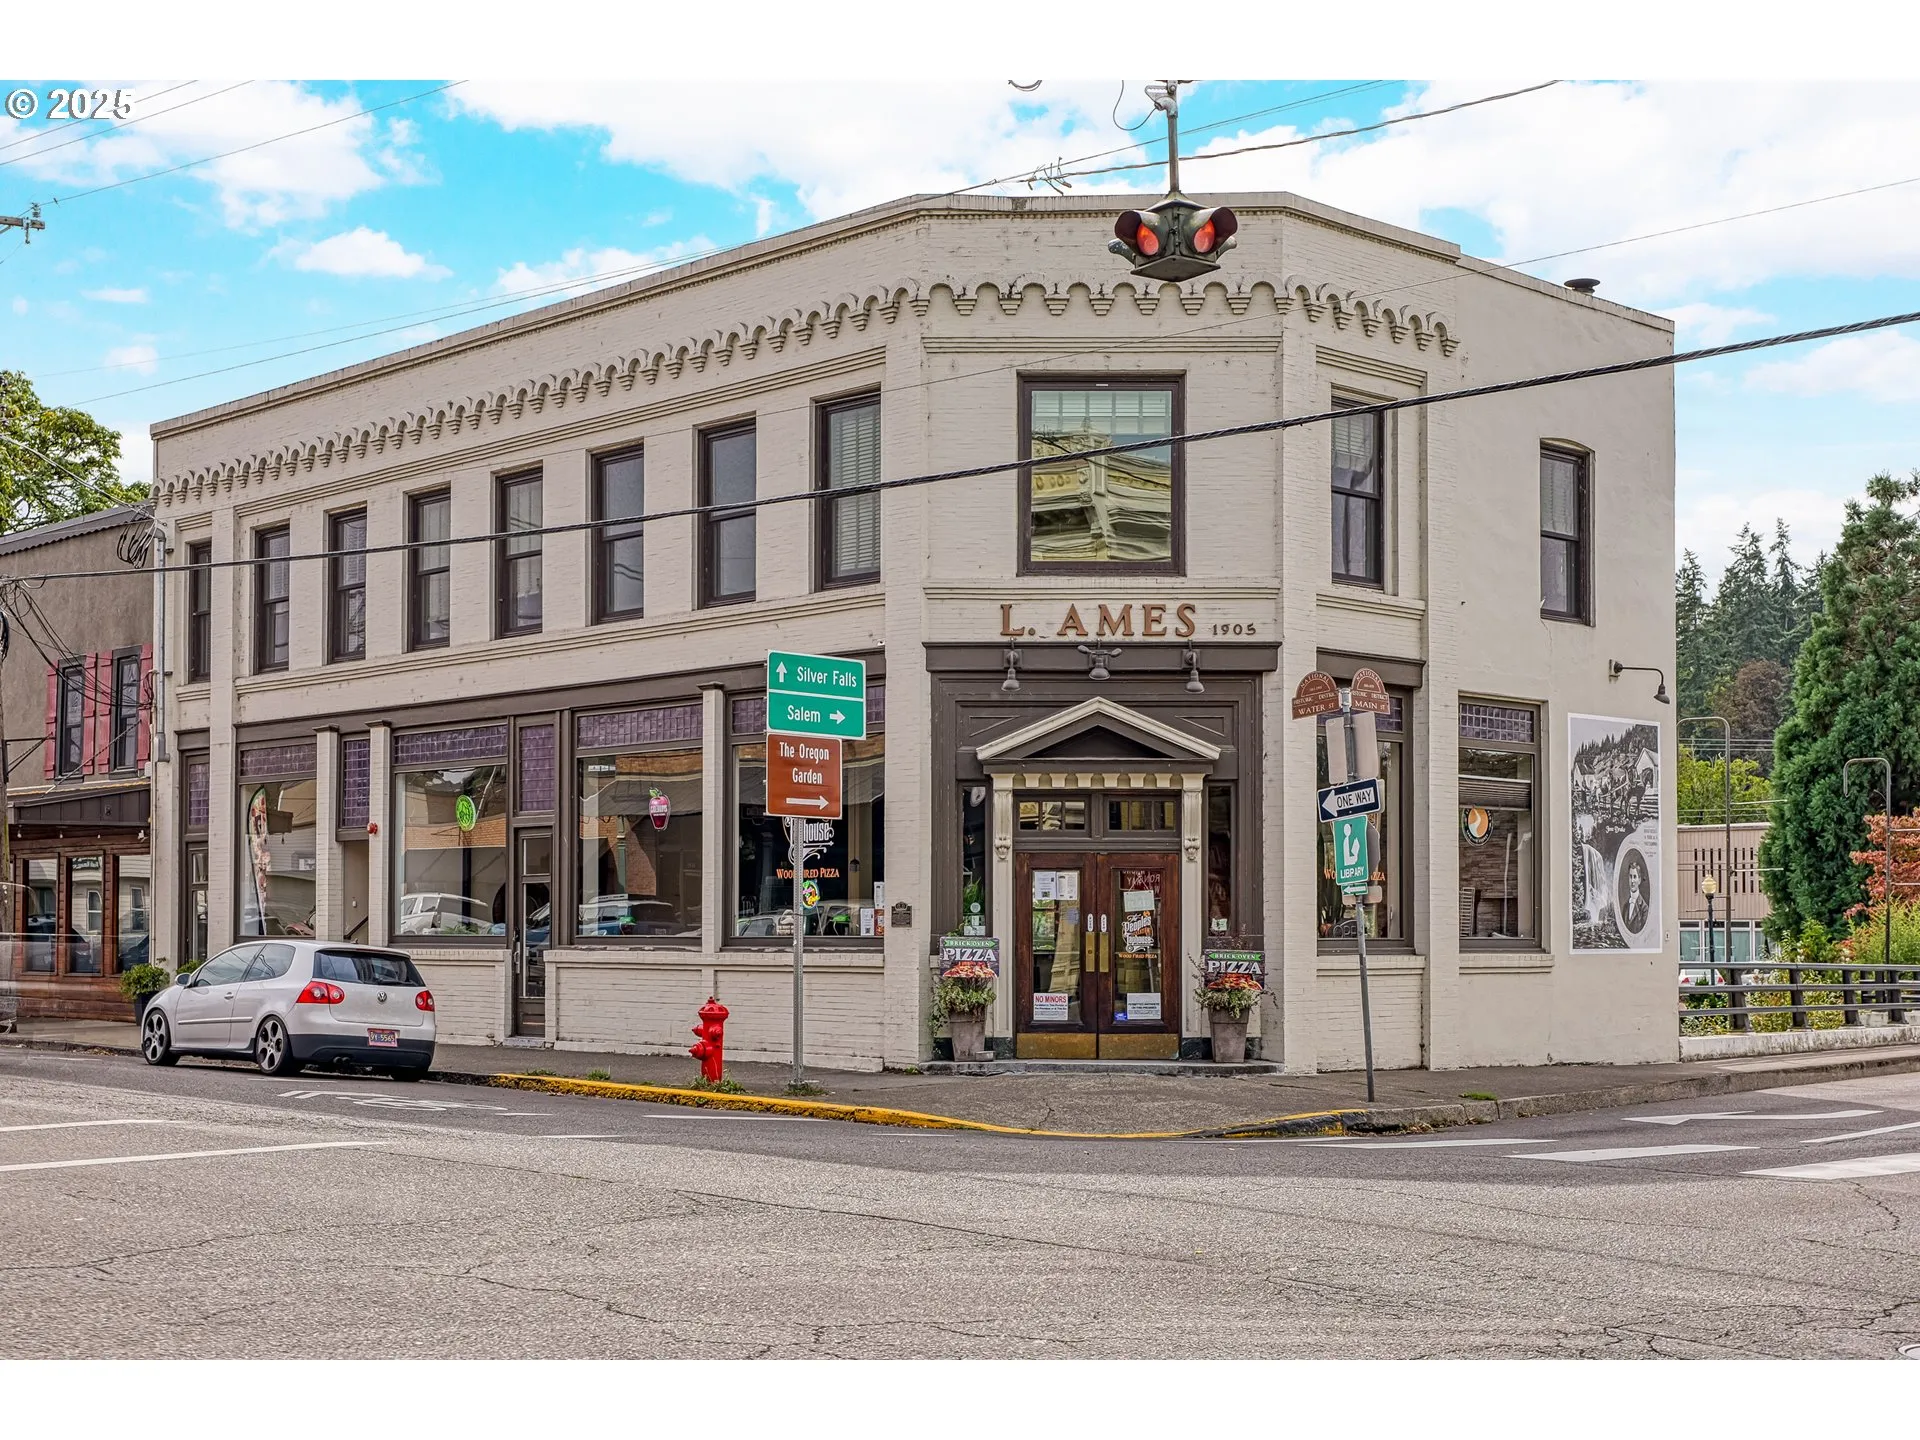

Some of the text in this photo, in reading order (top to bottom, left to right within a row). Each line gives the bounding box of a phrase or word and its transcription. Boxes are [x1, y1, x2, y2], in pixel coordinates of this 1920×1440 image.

[1000, 603, 1196, 637] L. AMES
[1212, 623, 1257, 636] 1905
[797, 666, 857, 688] Silver Falls
[1300, 673, 1330, 689] NATIONAL
[1356, 670, 1381, 684] NATIONAL
[1298, 704, 1326, 715] WATER
[1354, 700, 1378, 710] MAIN
[787, 705, 821, 723] Salem
[779, 742, 830, 764] The Oregon
[792, 767, 823, 785] Garden
[1336, 789, 1373, 808] ONE WAY
[776, 867, 840, 879] WOO IRED PIZZA
[1340, 866, 1365, 879] LIBRARY
[943, 948, 997, 961] PIZZA
[1207, 961, 1262, 974] PIZZA
[1035, 995, 1067, 1003] NO MINORS
